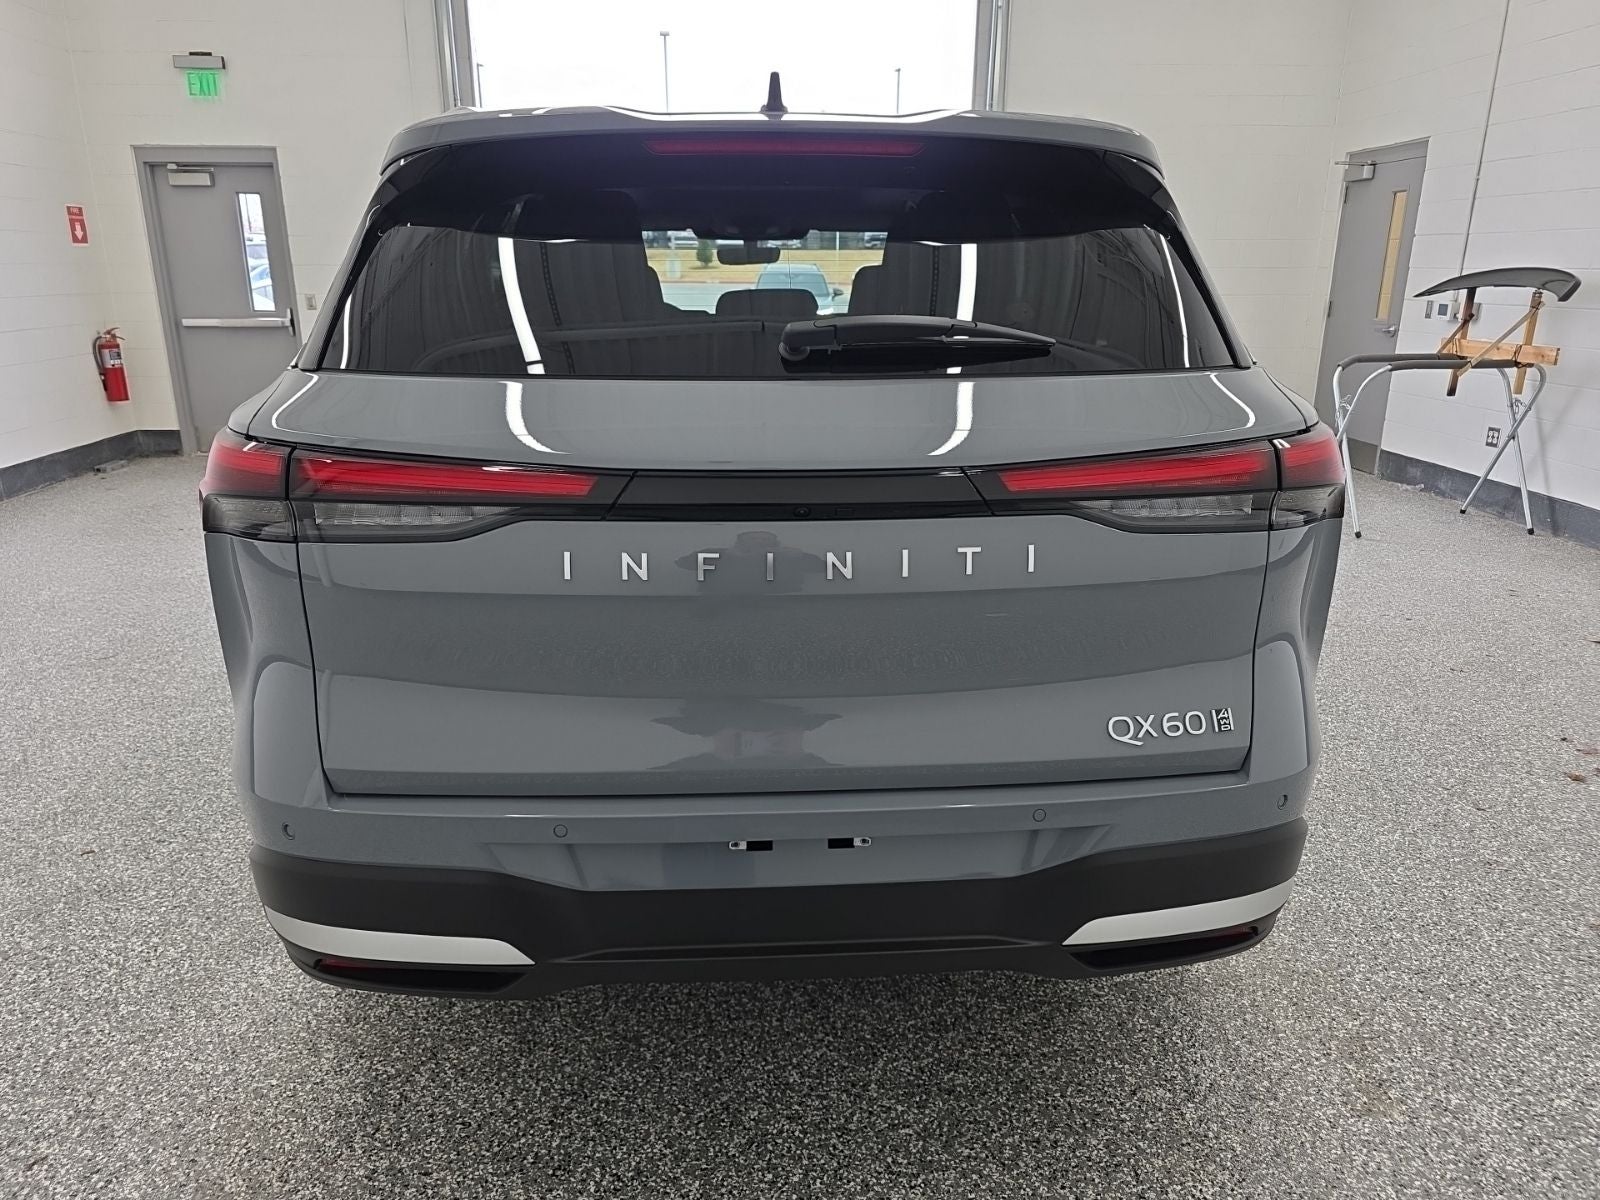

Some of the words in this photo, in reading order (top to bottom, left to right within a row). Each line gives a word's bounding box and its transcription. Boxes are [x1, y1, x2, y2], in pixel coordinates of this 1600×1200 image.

[187, 72, 219, 97] EXIT
[563, 544, 1035, 581] INFINITI
[1107, 710, 1206, 746] QX60
[1217, 708, 1231, 731] AWD
